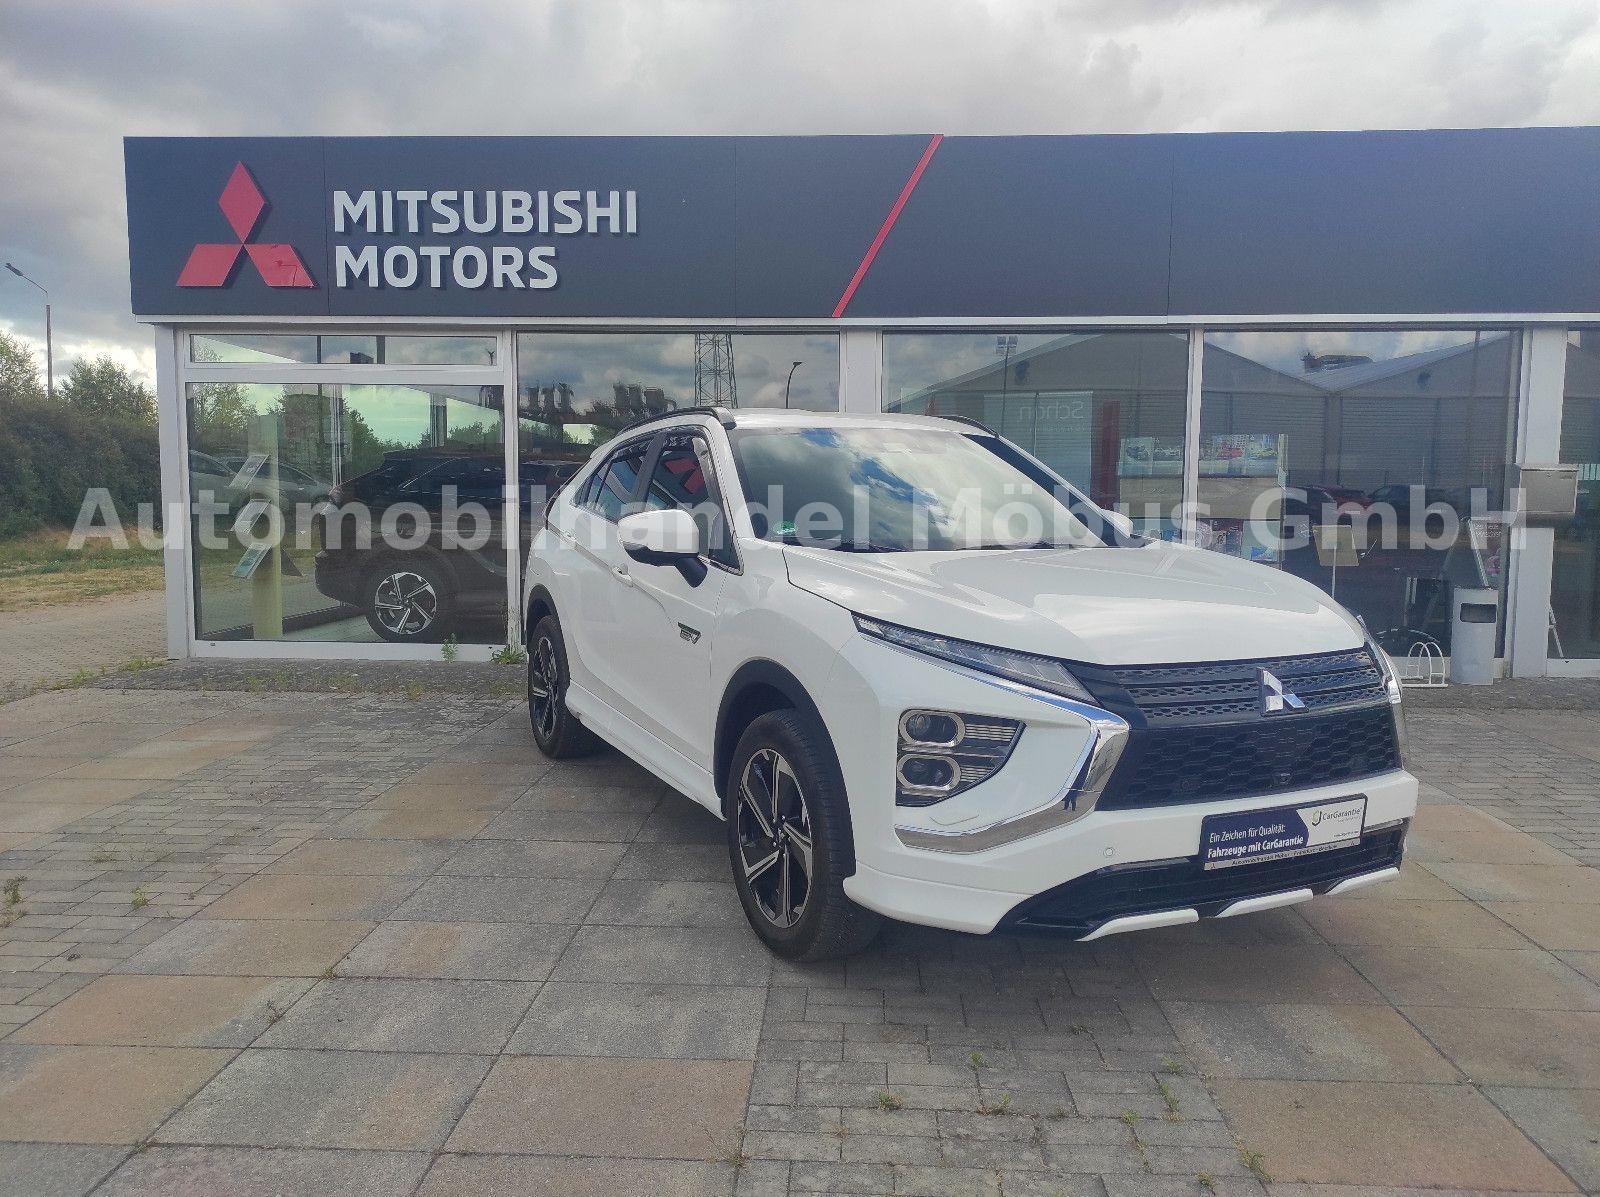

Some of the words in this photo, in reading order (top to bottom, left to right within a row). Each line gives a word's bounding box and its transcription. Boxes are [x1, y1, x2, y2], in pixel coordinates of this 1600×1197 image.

[333, 190, 637, 234] MITSUBISHI
[336, 245, 559, 289] MOTORS
[1207, 846, 1247, 858] Fahrzeuge
[1247, 842, 1261, 853] mit
[1262, 835, 1304, 850] CarGarantie
[1209, 833, 1220, 844] Ein
[1221, 829, 1247, 842] Zeichen
[1248, 827, 1258, 838] für
